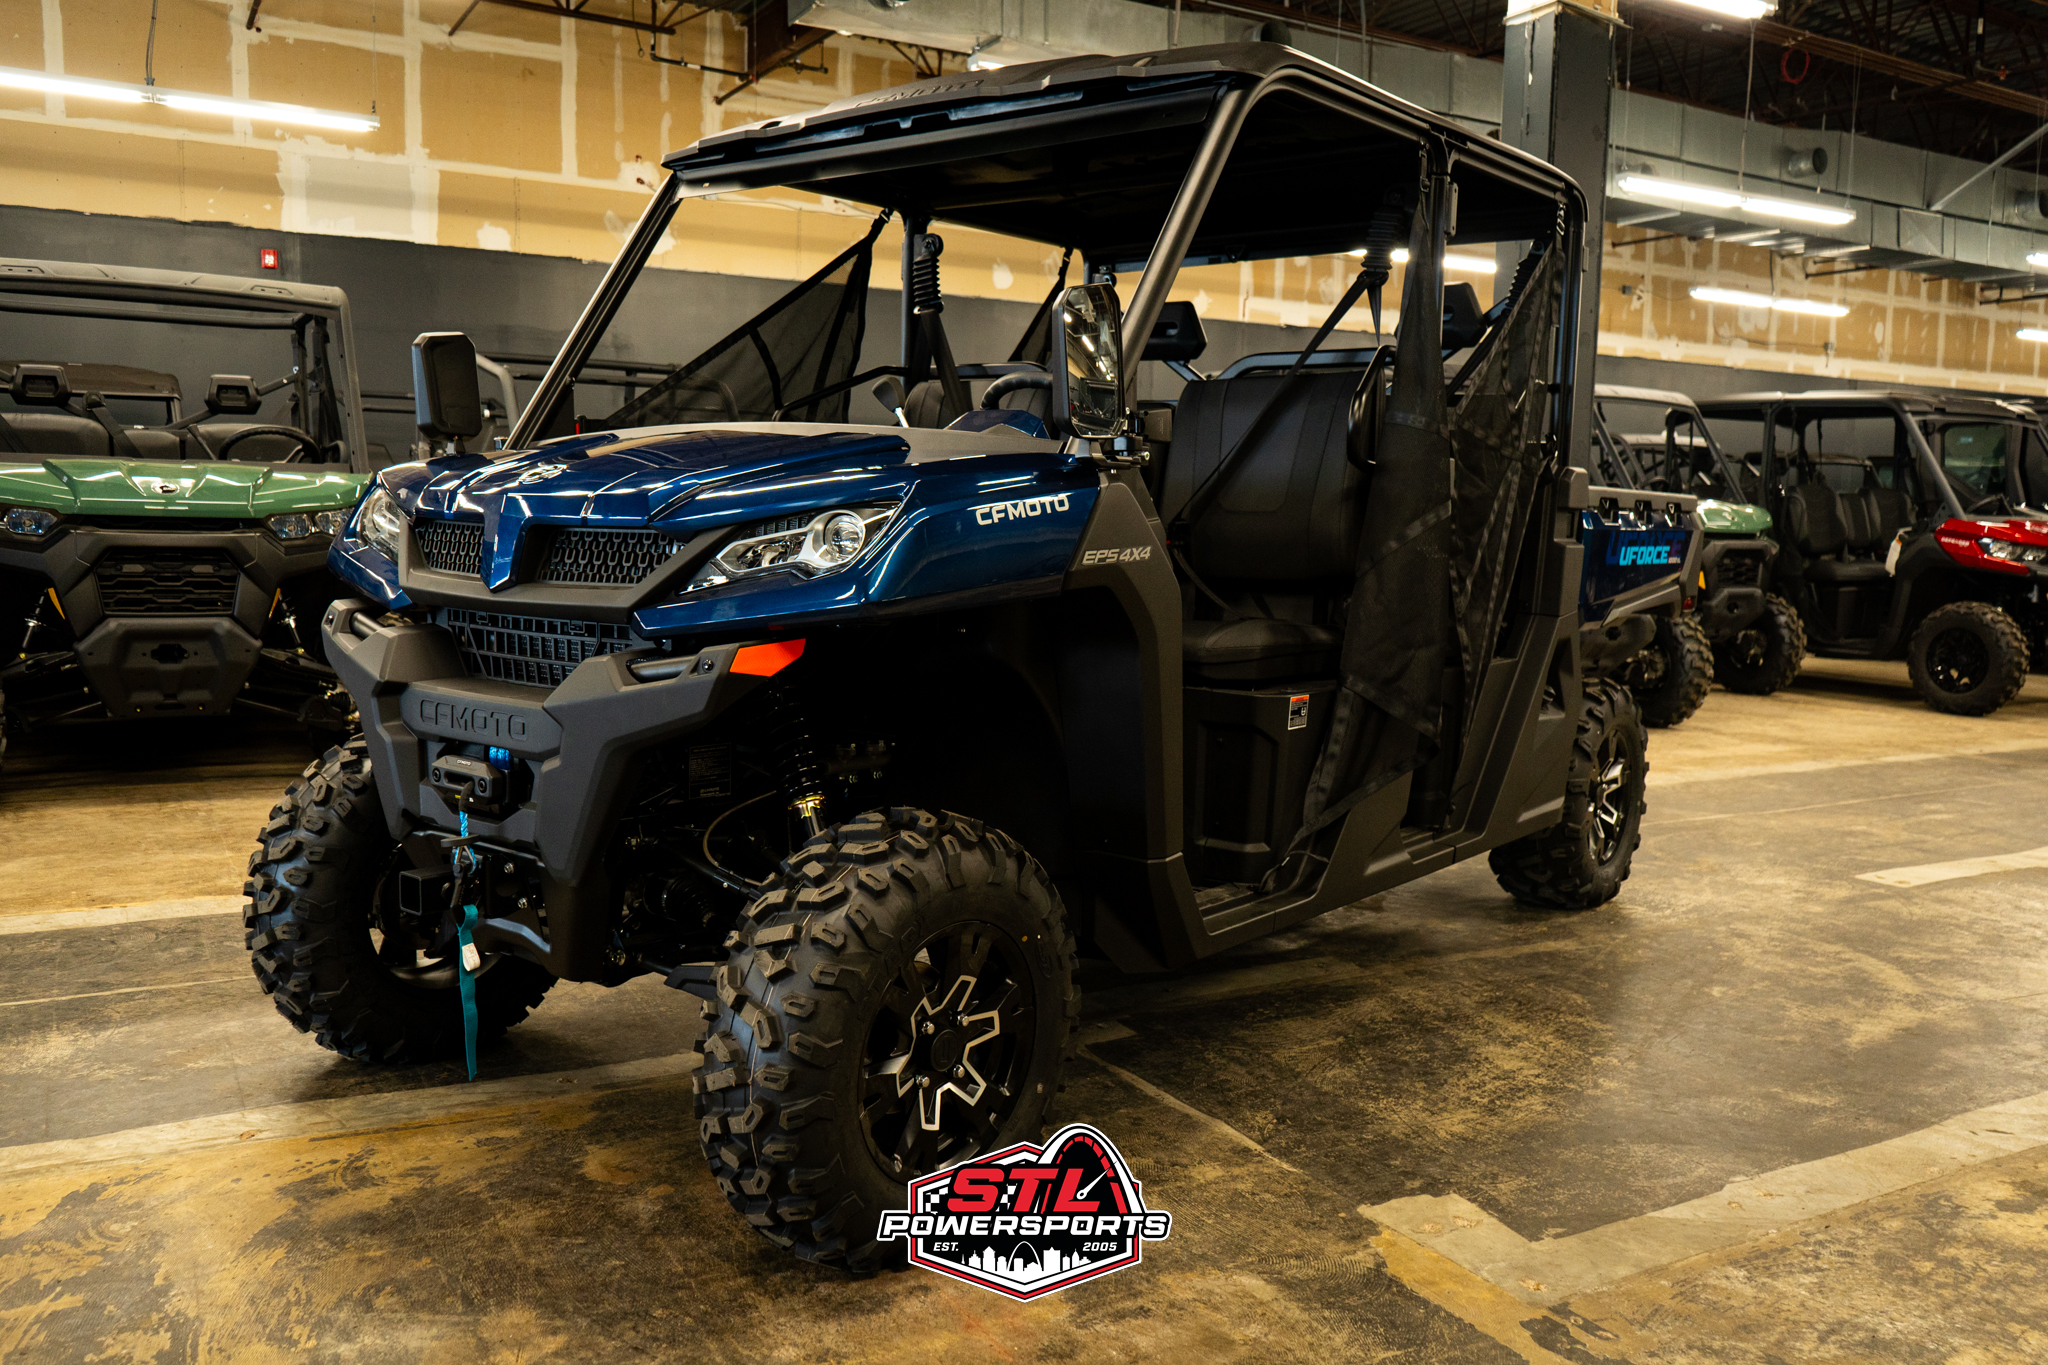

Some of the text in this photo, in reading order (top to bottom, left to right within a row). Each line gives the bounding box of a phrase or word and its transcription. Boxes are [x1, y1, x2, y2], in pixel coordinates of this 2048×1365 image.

[976, 495, 1069, 526] CFMOTO
[1081, 546, 1152, 565] EPS 4X4
[1619, 545, 1671, 566] UFORCE
[420, 699, 528, 741] CFMOTO
